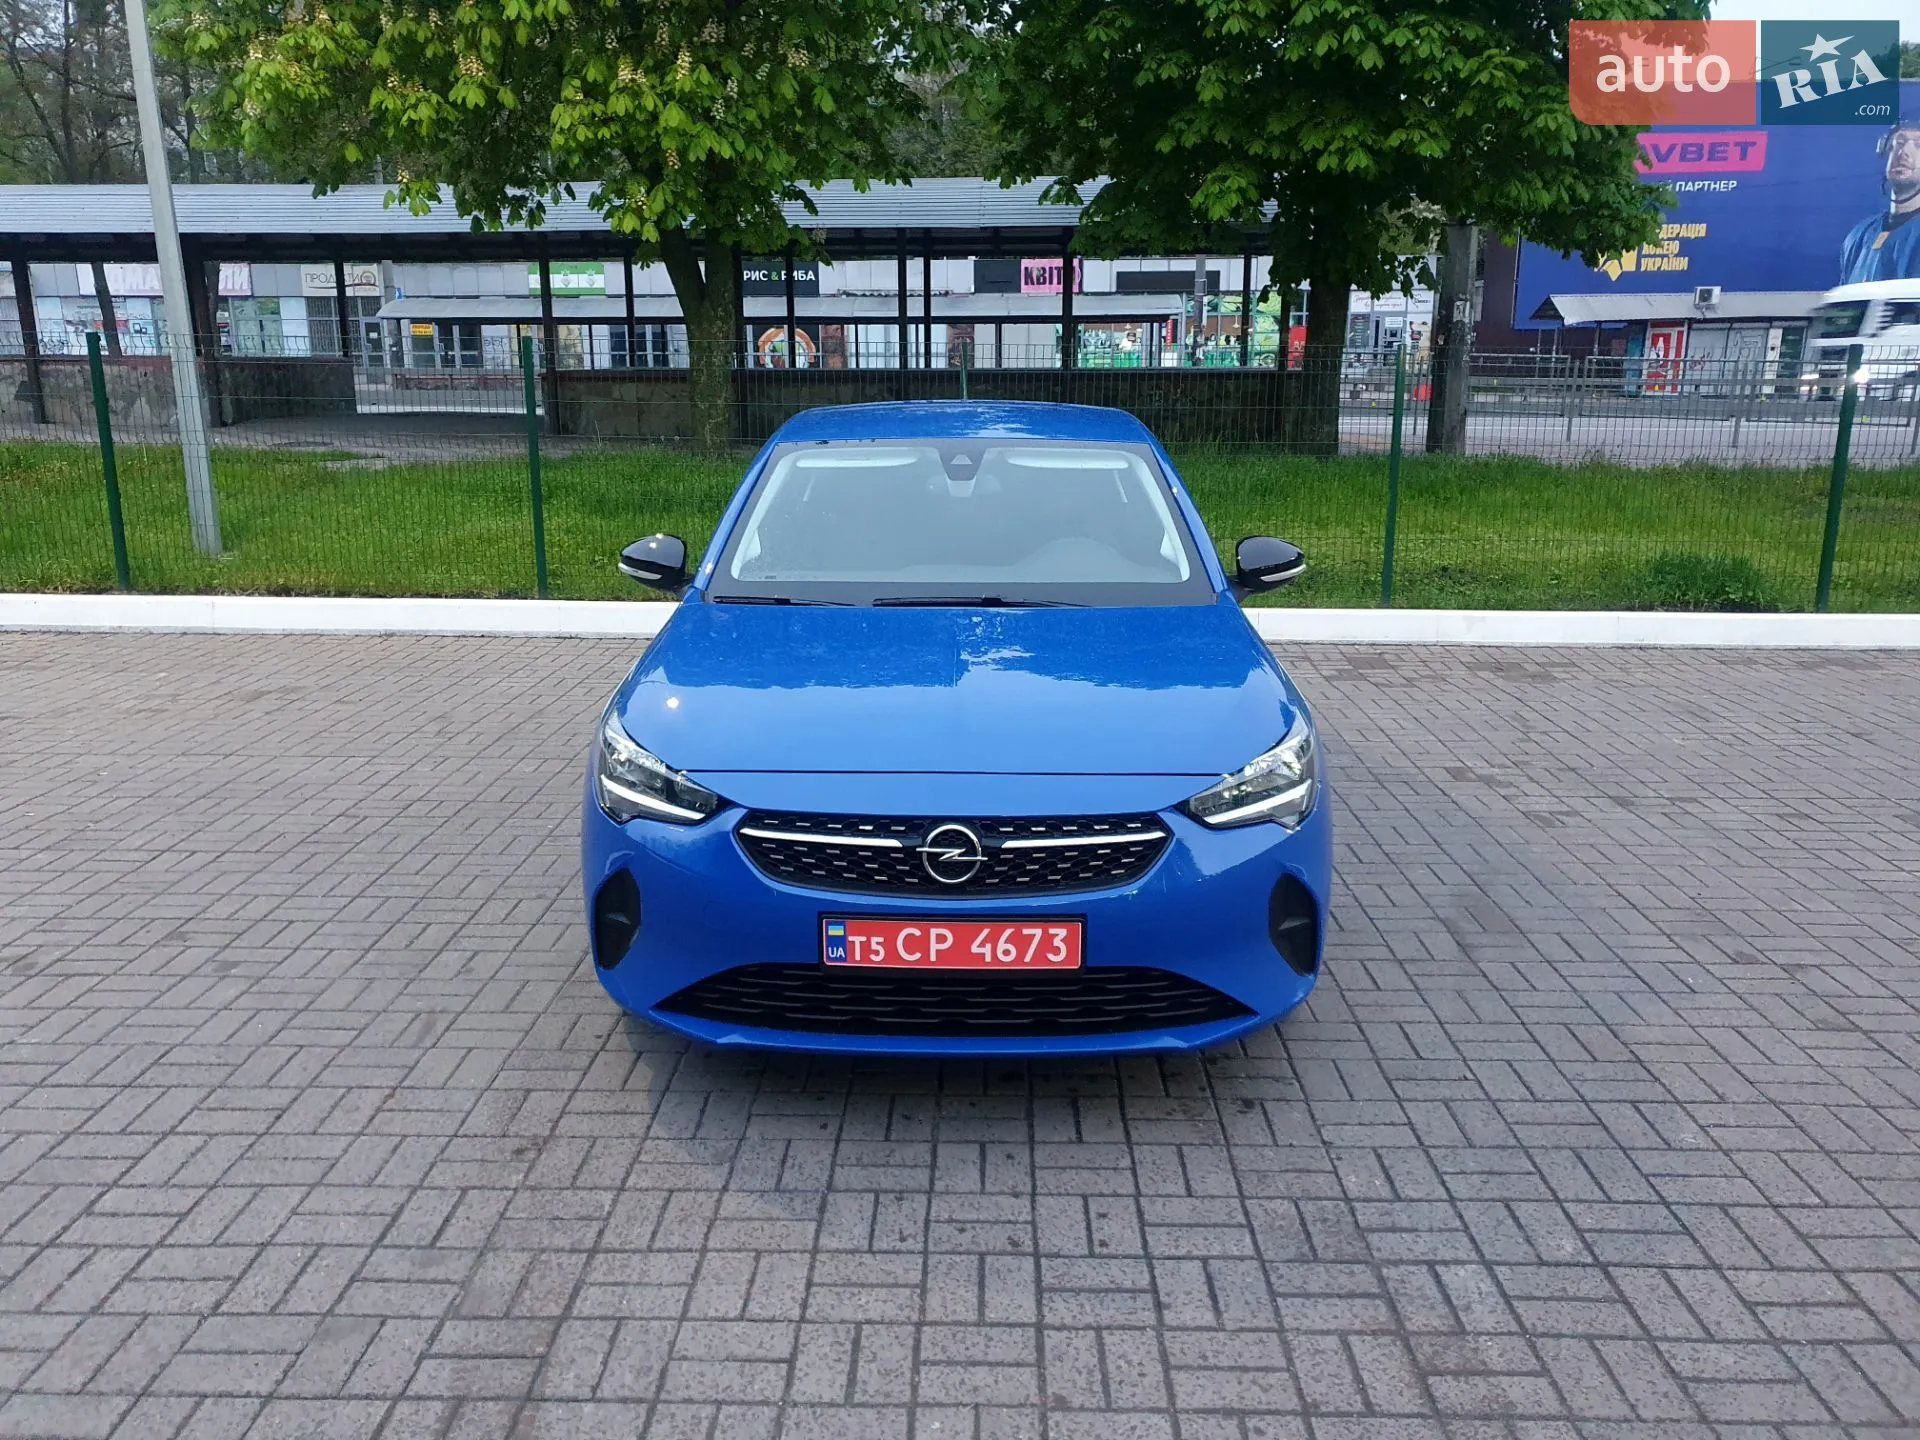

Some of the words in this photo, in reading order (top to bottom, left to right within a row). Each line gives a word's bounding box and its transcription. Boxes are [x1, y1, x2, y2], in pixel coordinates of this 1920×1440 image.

[1640, 141, 1757, 163] VBET
[1675, 180, 1737, 192] ПАРТНЕР
[1656, 223, 1707, 239] ДЕРАЦІЯ
[1640, 256, 1689, 272] УКРАЇНИ
[743, 269, 769, 281] РИС
[771, 271, 780, 281] &
[1024, 266, 1075, 285] КВІТ
[828, 947, 846, 959] UA
[848, 936, 886, 962] T5
[970, 928, 1068, 963] 4673
